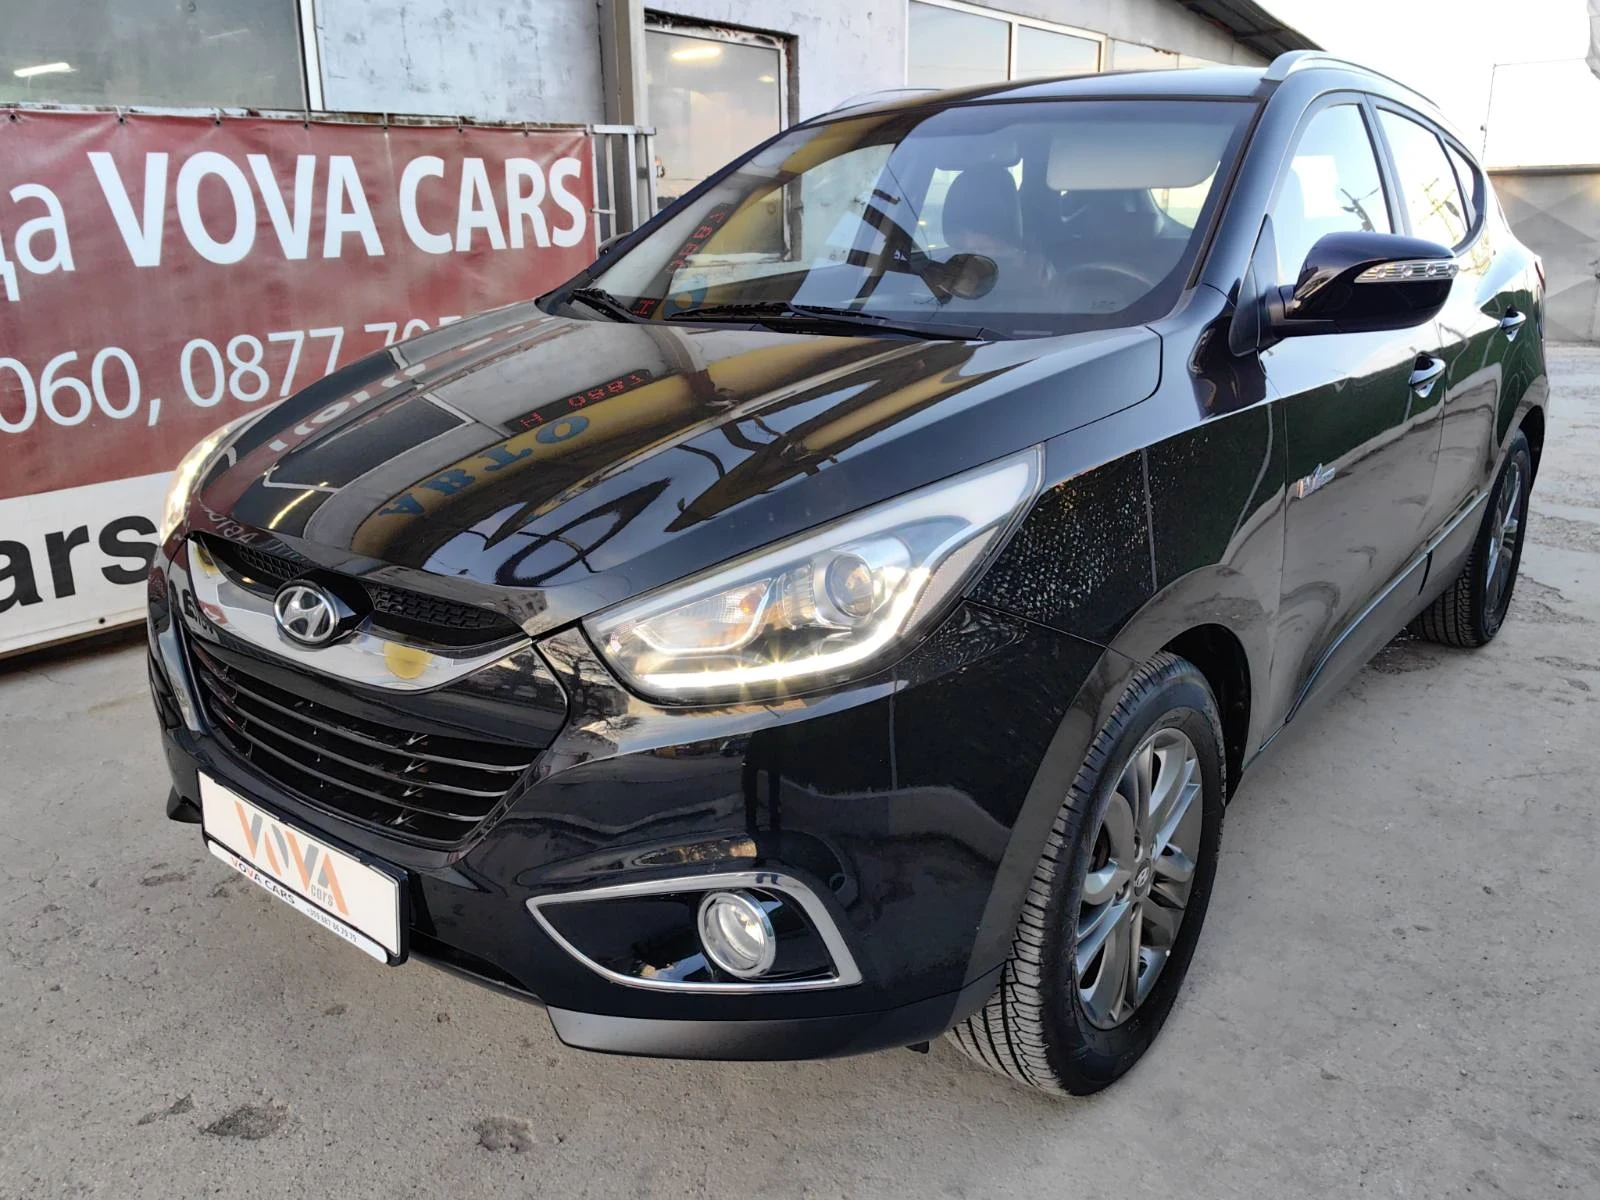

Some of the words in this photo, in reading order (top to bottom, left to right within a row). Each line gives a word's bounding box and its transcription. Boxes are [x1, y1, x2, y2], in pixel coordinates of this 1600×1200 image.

[87, 151, 385, 267] VOVA
[399, 155, 587, 254] CARS
[181, 327, 345, 407] 0877
[231, 856, 262, 883] VOVA
[264, 880, 295, 904] CARS
[234, 801, 349, 916] VOVA
[311, 884, 333, 907] cars
